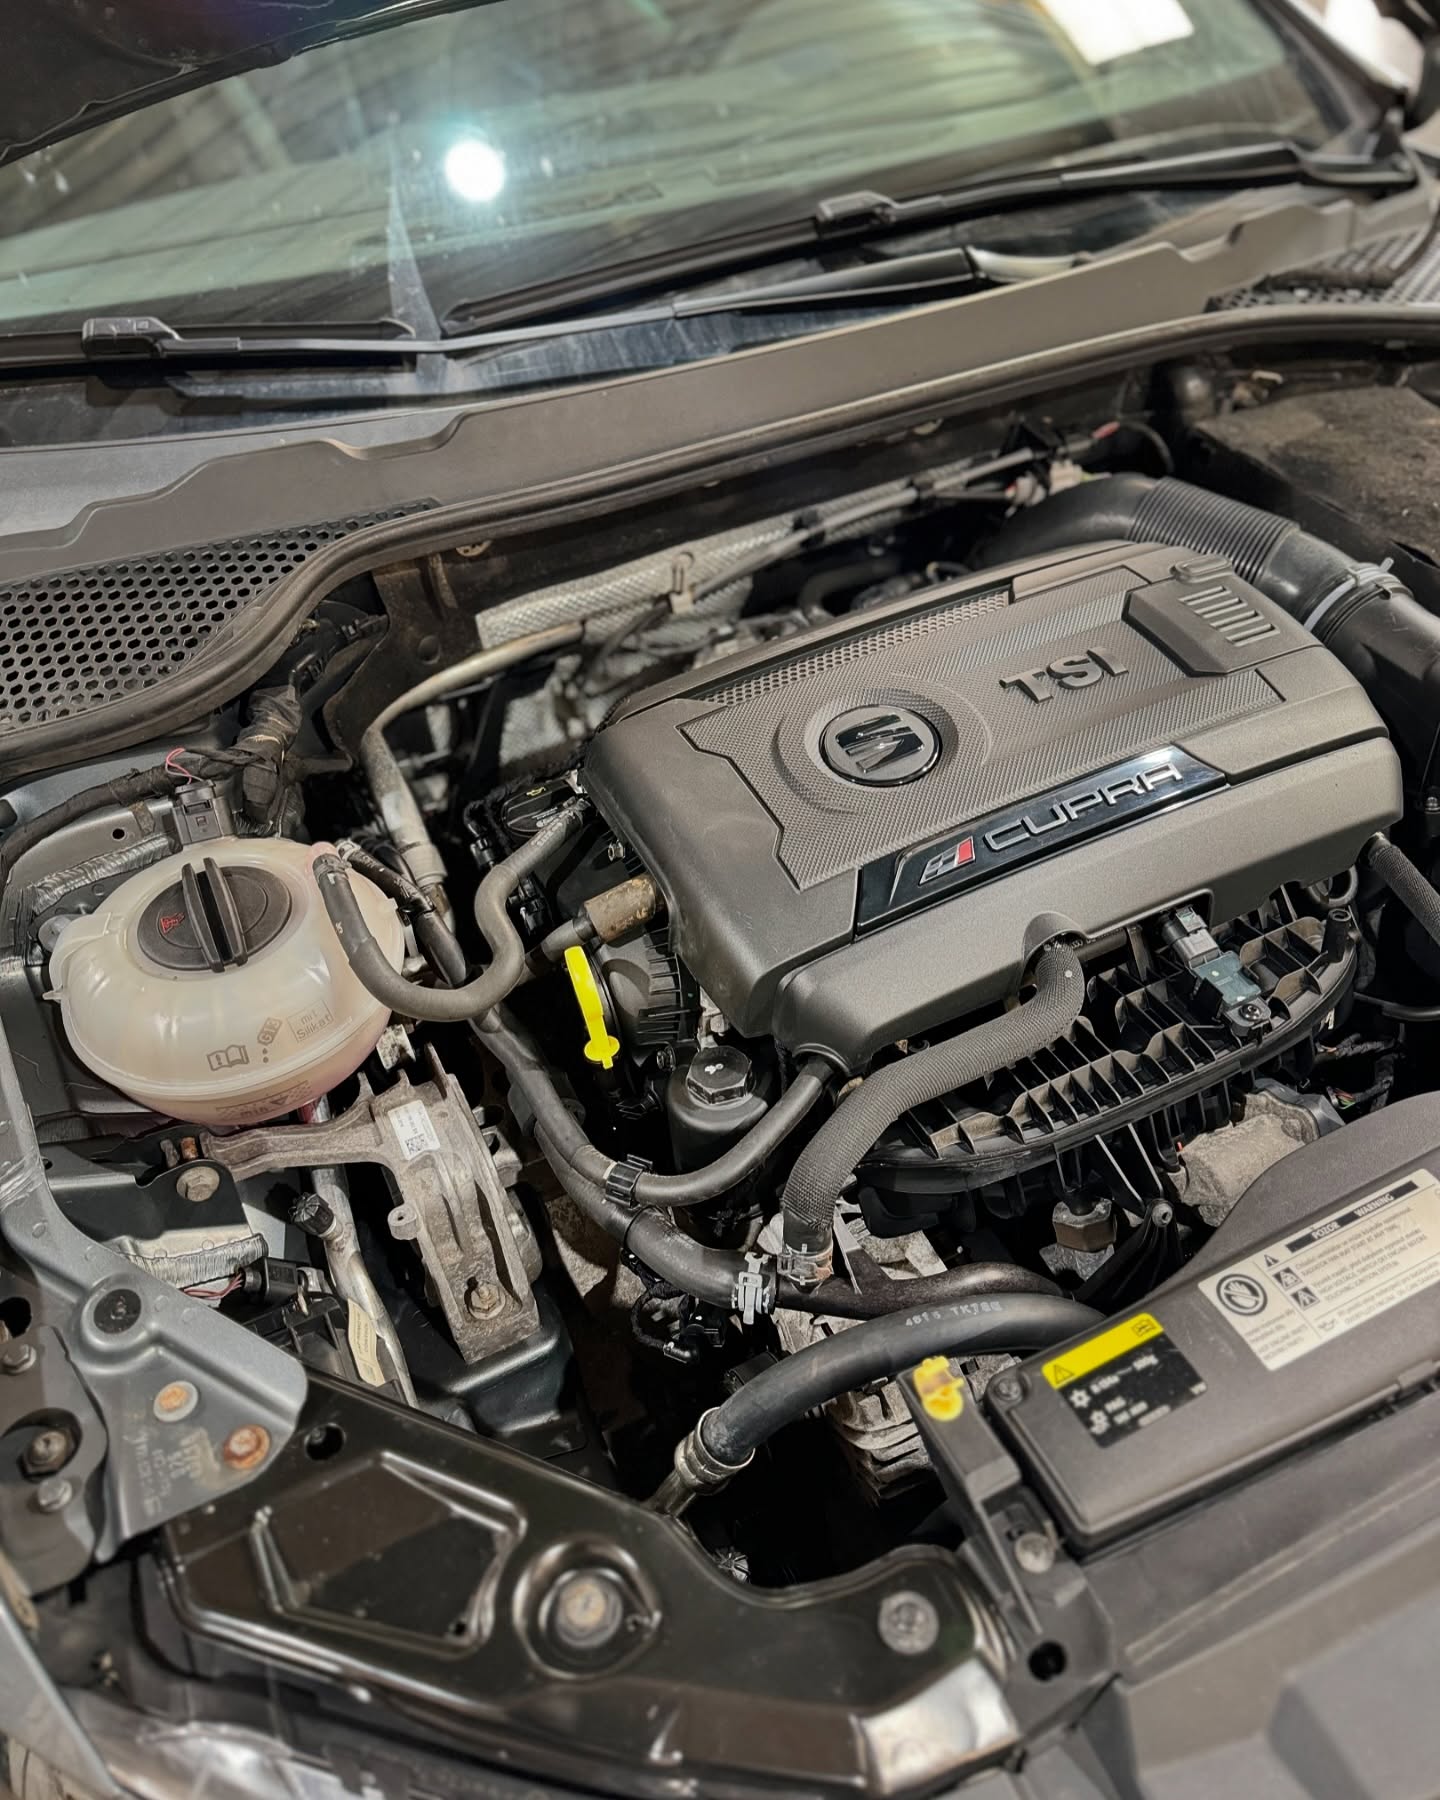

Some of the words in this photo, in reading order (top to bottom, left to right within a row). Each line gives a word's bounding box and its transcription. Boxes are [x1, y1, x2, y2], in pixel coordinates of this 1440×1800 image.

[999, 647, 1129, 704] TSI
[983, 762, 1183, 851] CUPRA
[1311, 1221, 1341, 1240] POZOR
[1354, 1193, 1395, 1217] WARNING
